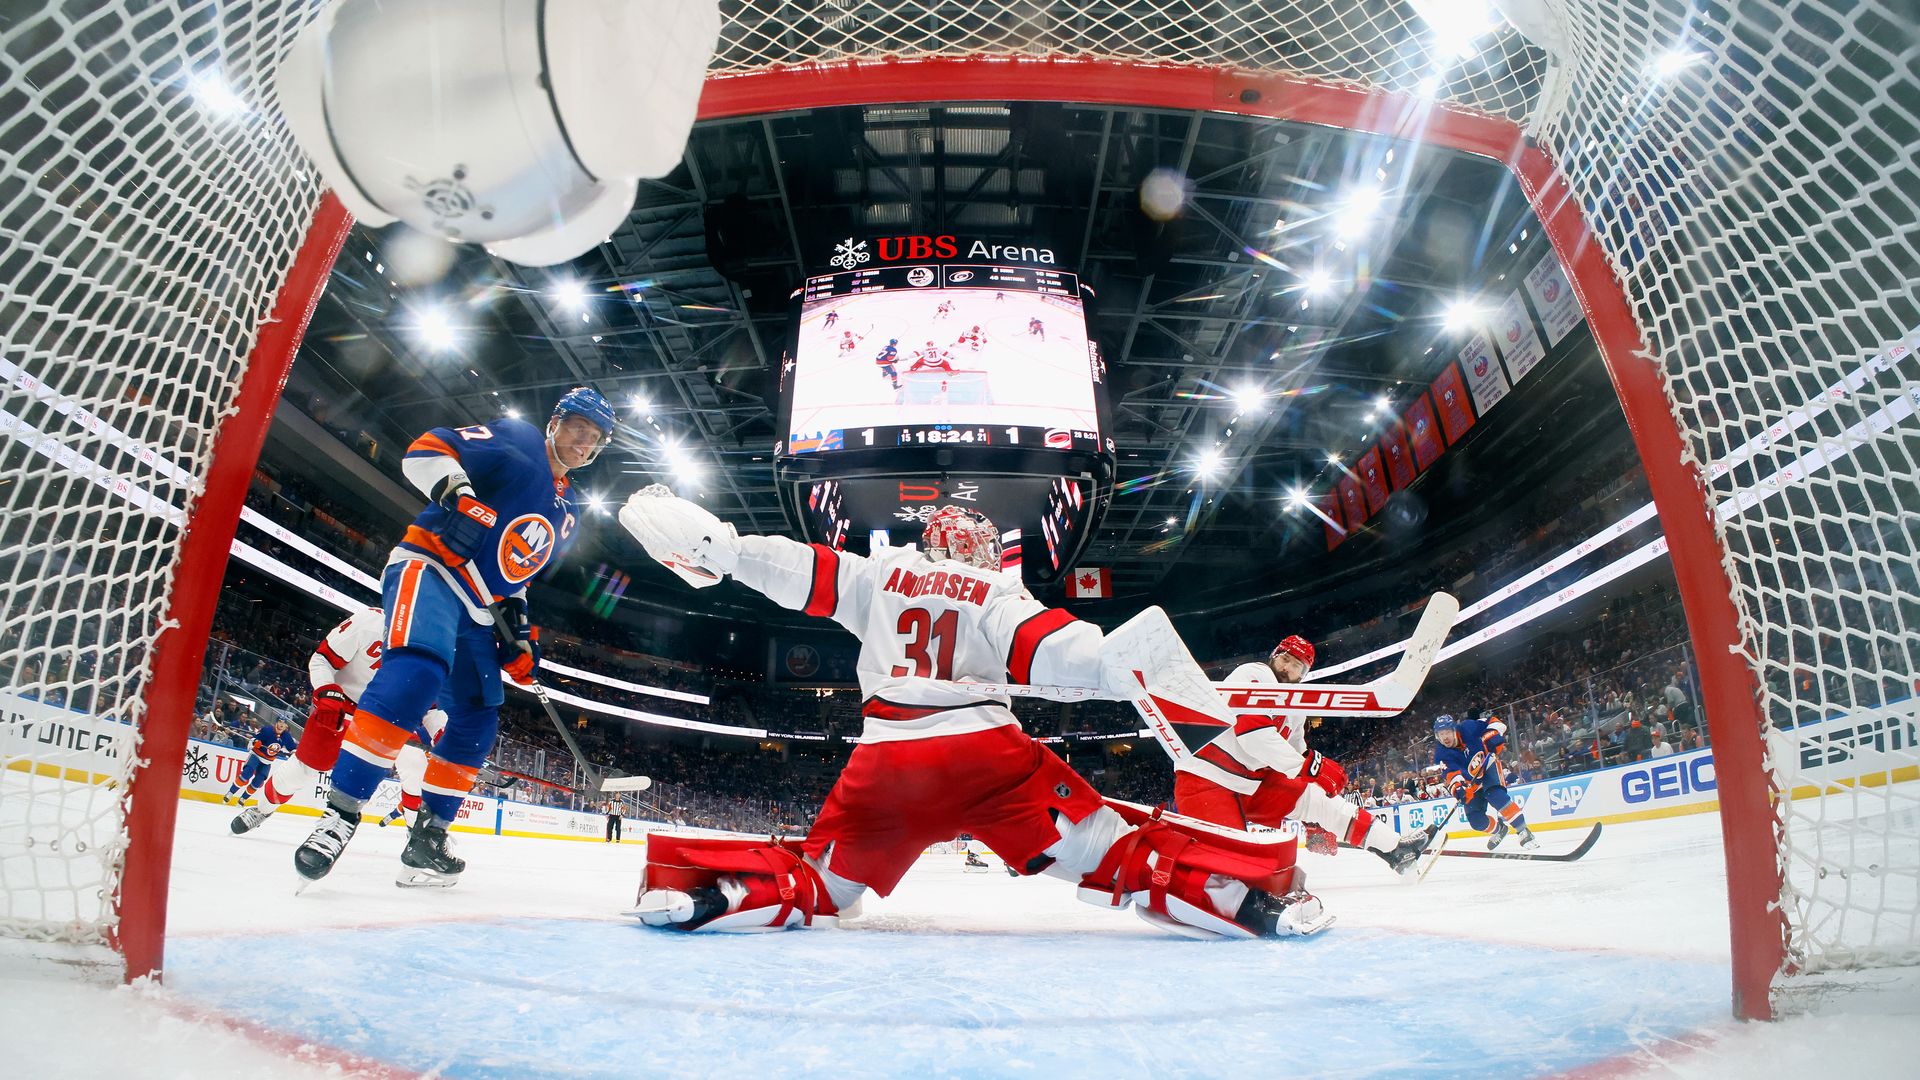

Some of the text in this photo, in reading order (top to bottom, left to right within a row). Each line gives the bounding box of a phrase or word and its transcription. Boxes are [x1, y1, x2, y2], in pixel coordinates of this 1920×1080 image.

[876, 235, 1056, 264] UBS Arena
[1088, 340, 1102, 384] Heineken
[84, 415, 98, 429] US
[861, 428, 875, 446] 1
[901, 430, 987, 444] 15 18:24 21
[1005, 427, 1019, 445] 1
[561, 513, 576, 540] C
[671, 552, 691, 564] TRUE
[883, 567, 992, 607] ANDERSEN
[890, 607, 960, 681] 31
[1219, 690, 1368, 709] TRUE
[1137, 699, 1181, 759] TRUE
[1621, 755, 1719, 804] GEIC
[1550, 785, 1583, 810] SAP
[1411, 811, 1424, 826] PPG
[1491, 852, 1533, 861] CCM
